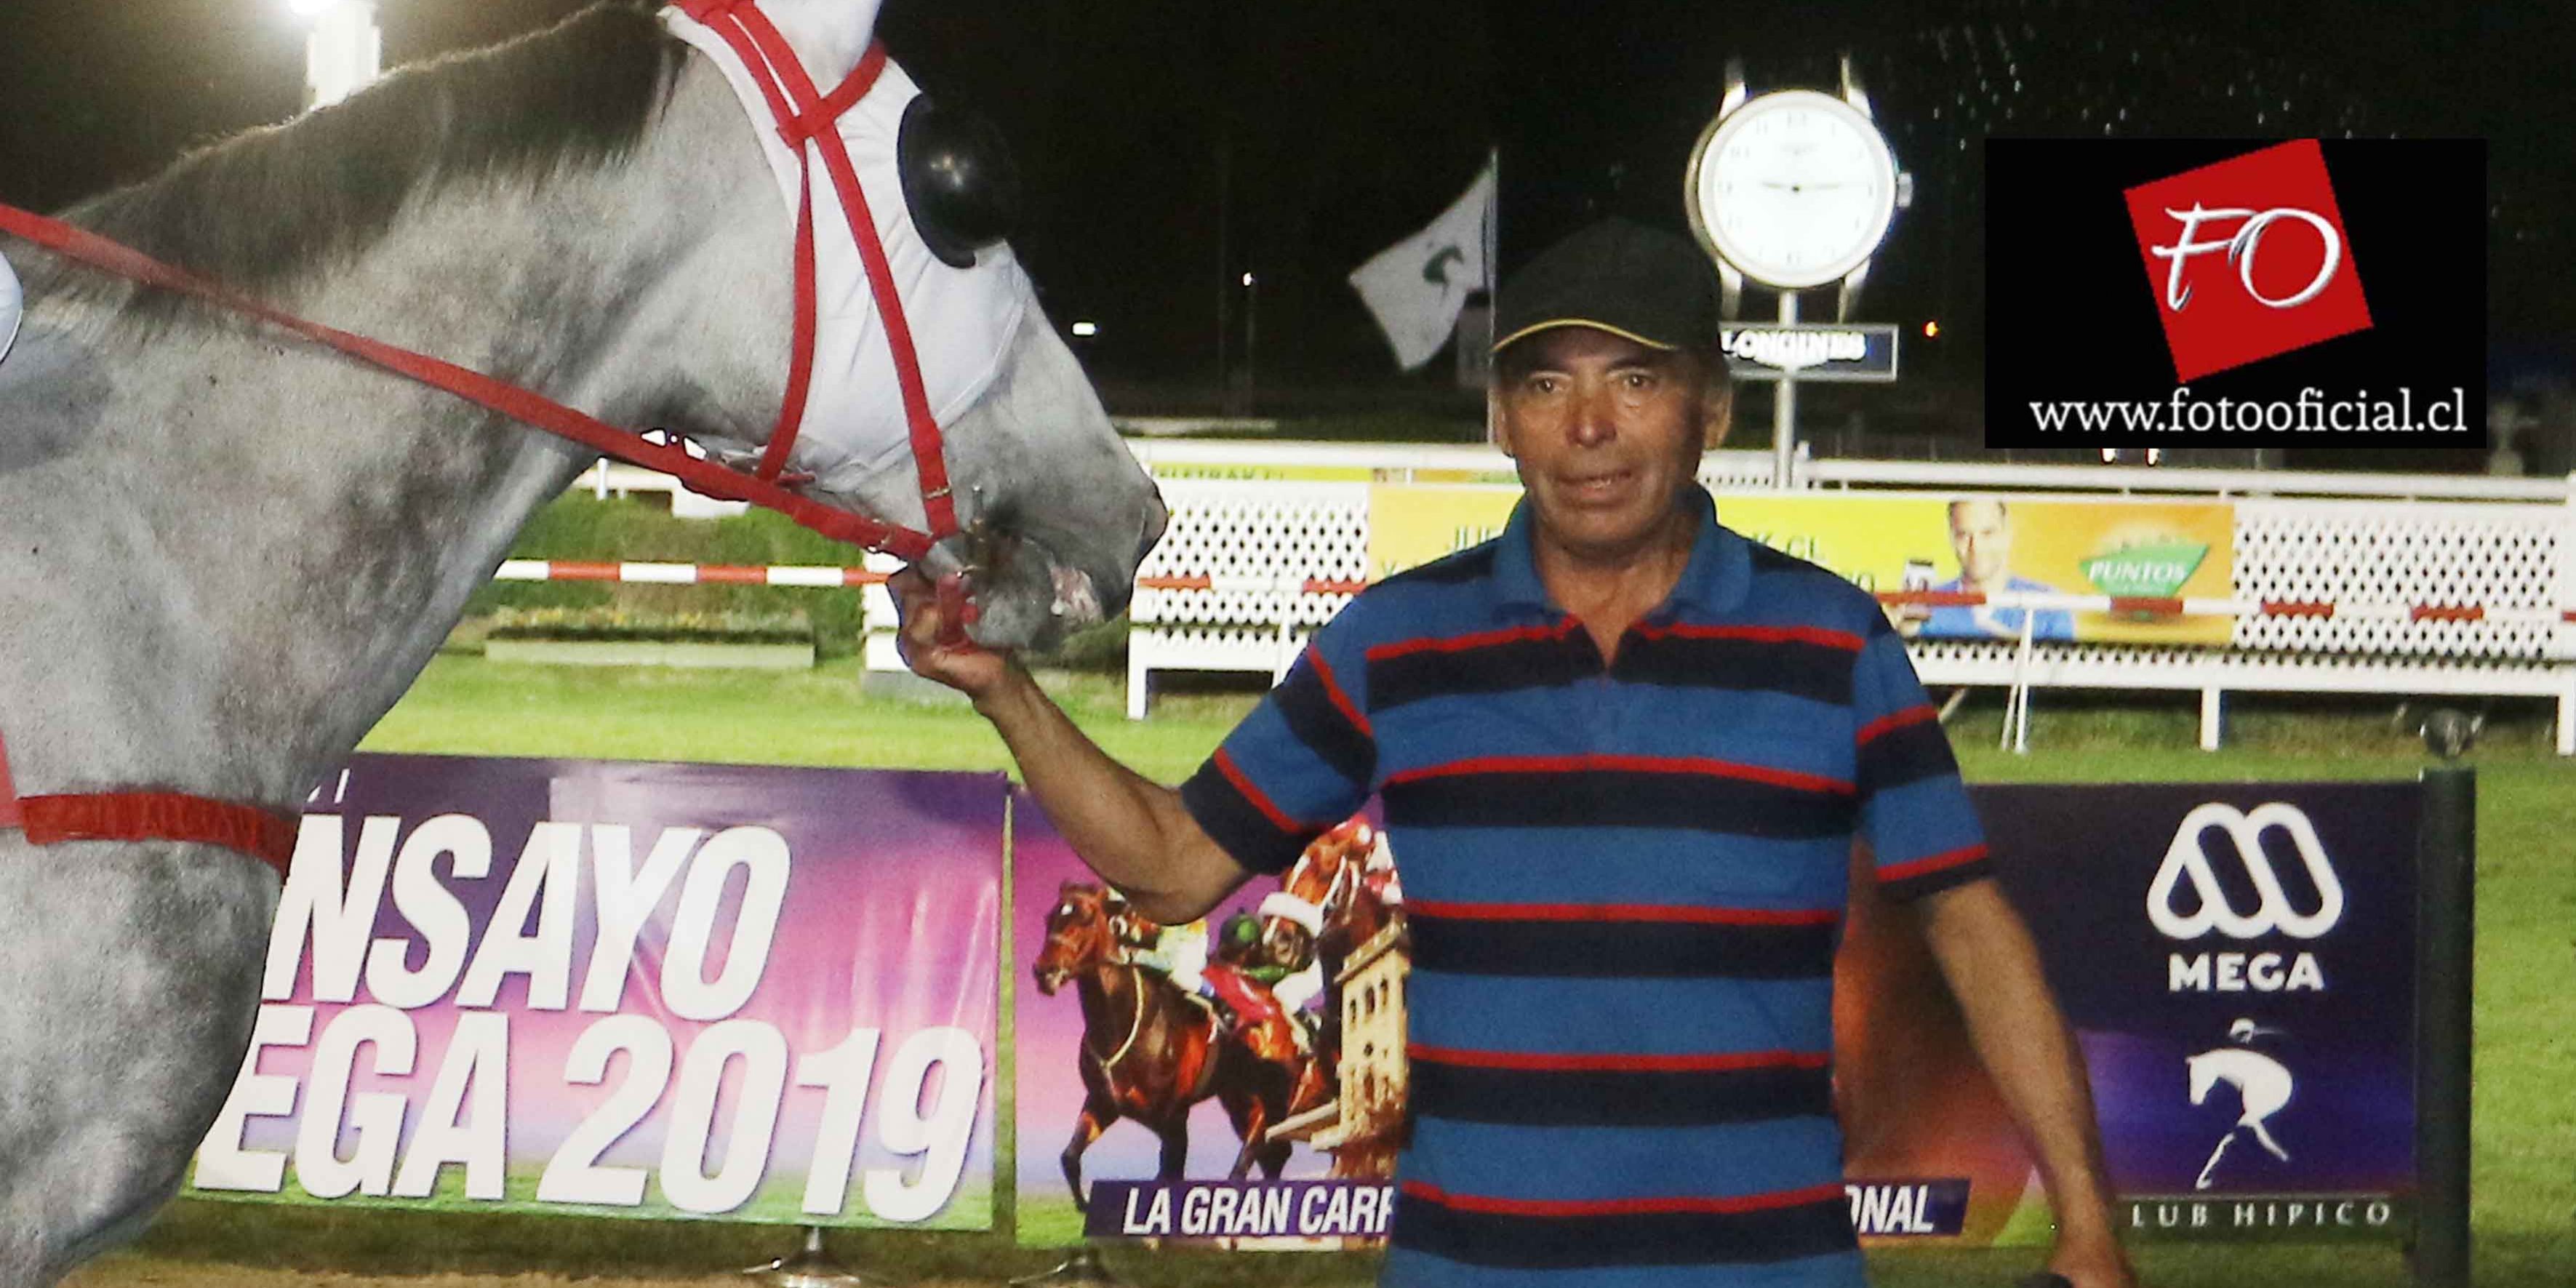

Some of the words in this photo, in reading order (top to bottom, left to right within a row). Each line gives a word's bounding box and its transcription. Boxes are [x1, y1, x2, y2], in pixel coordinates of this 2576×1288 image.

[2168, 953, 2325, 993] MEGA
[536, 1014, 983, 1222] 2019
[1123, 1187, 1171, 1234] LA
[1180, 1186, 1292, 1235] GRAN
[2234, 1202, 2391, 1228] HIPICO
